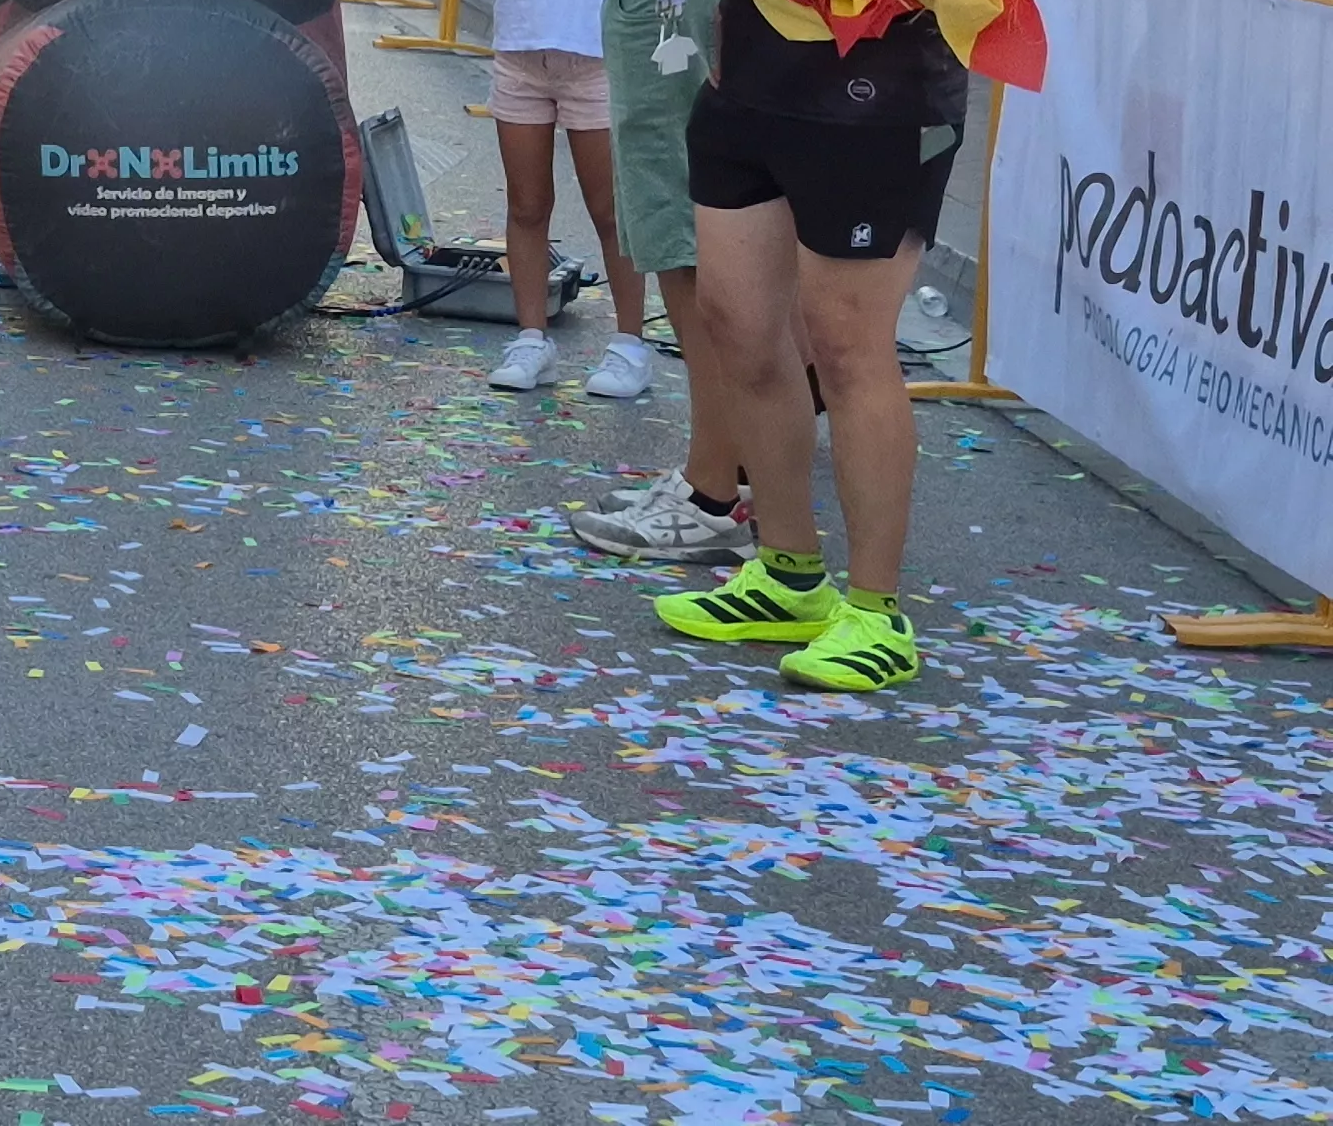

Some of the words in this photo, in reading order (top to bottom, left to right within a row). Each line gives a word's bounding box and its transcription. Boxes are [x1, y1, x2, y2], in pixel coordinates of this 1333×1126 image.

[96, 186, 152, 201] Servicio
[154, 186, 174, 200] de
[237, 188, 247, 202] y
[110, 203, 203, 220] promocional
[206, 202, 277, 220] deportivo
[1184, 352, 1198, 394] Y
